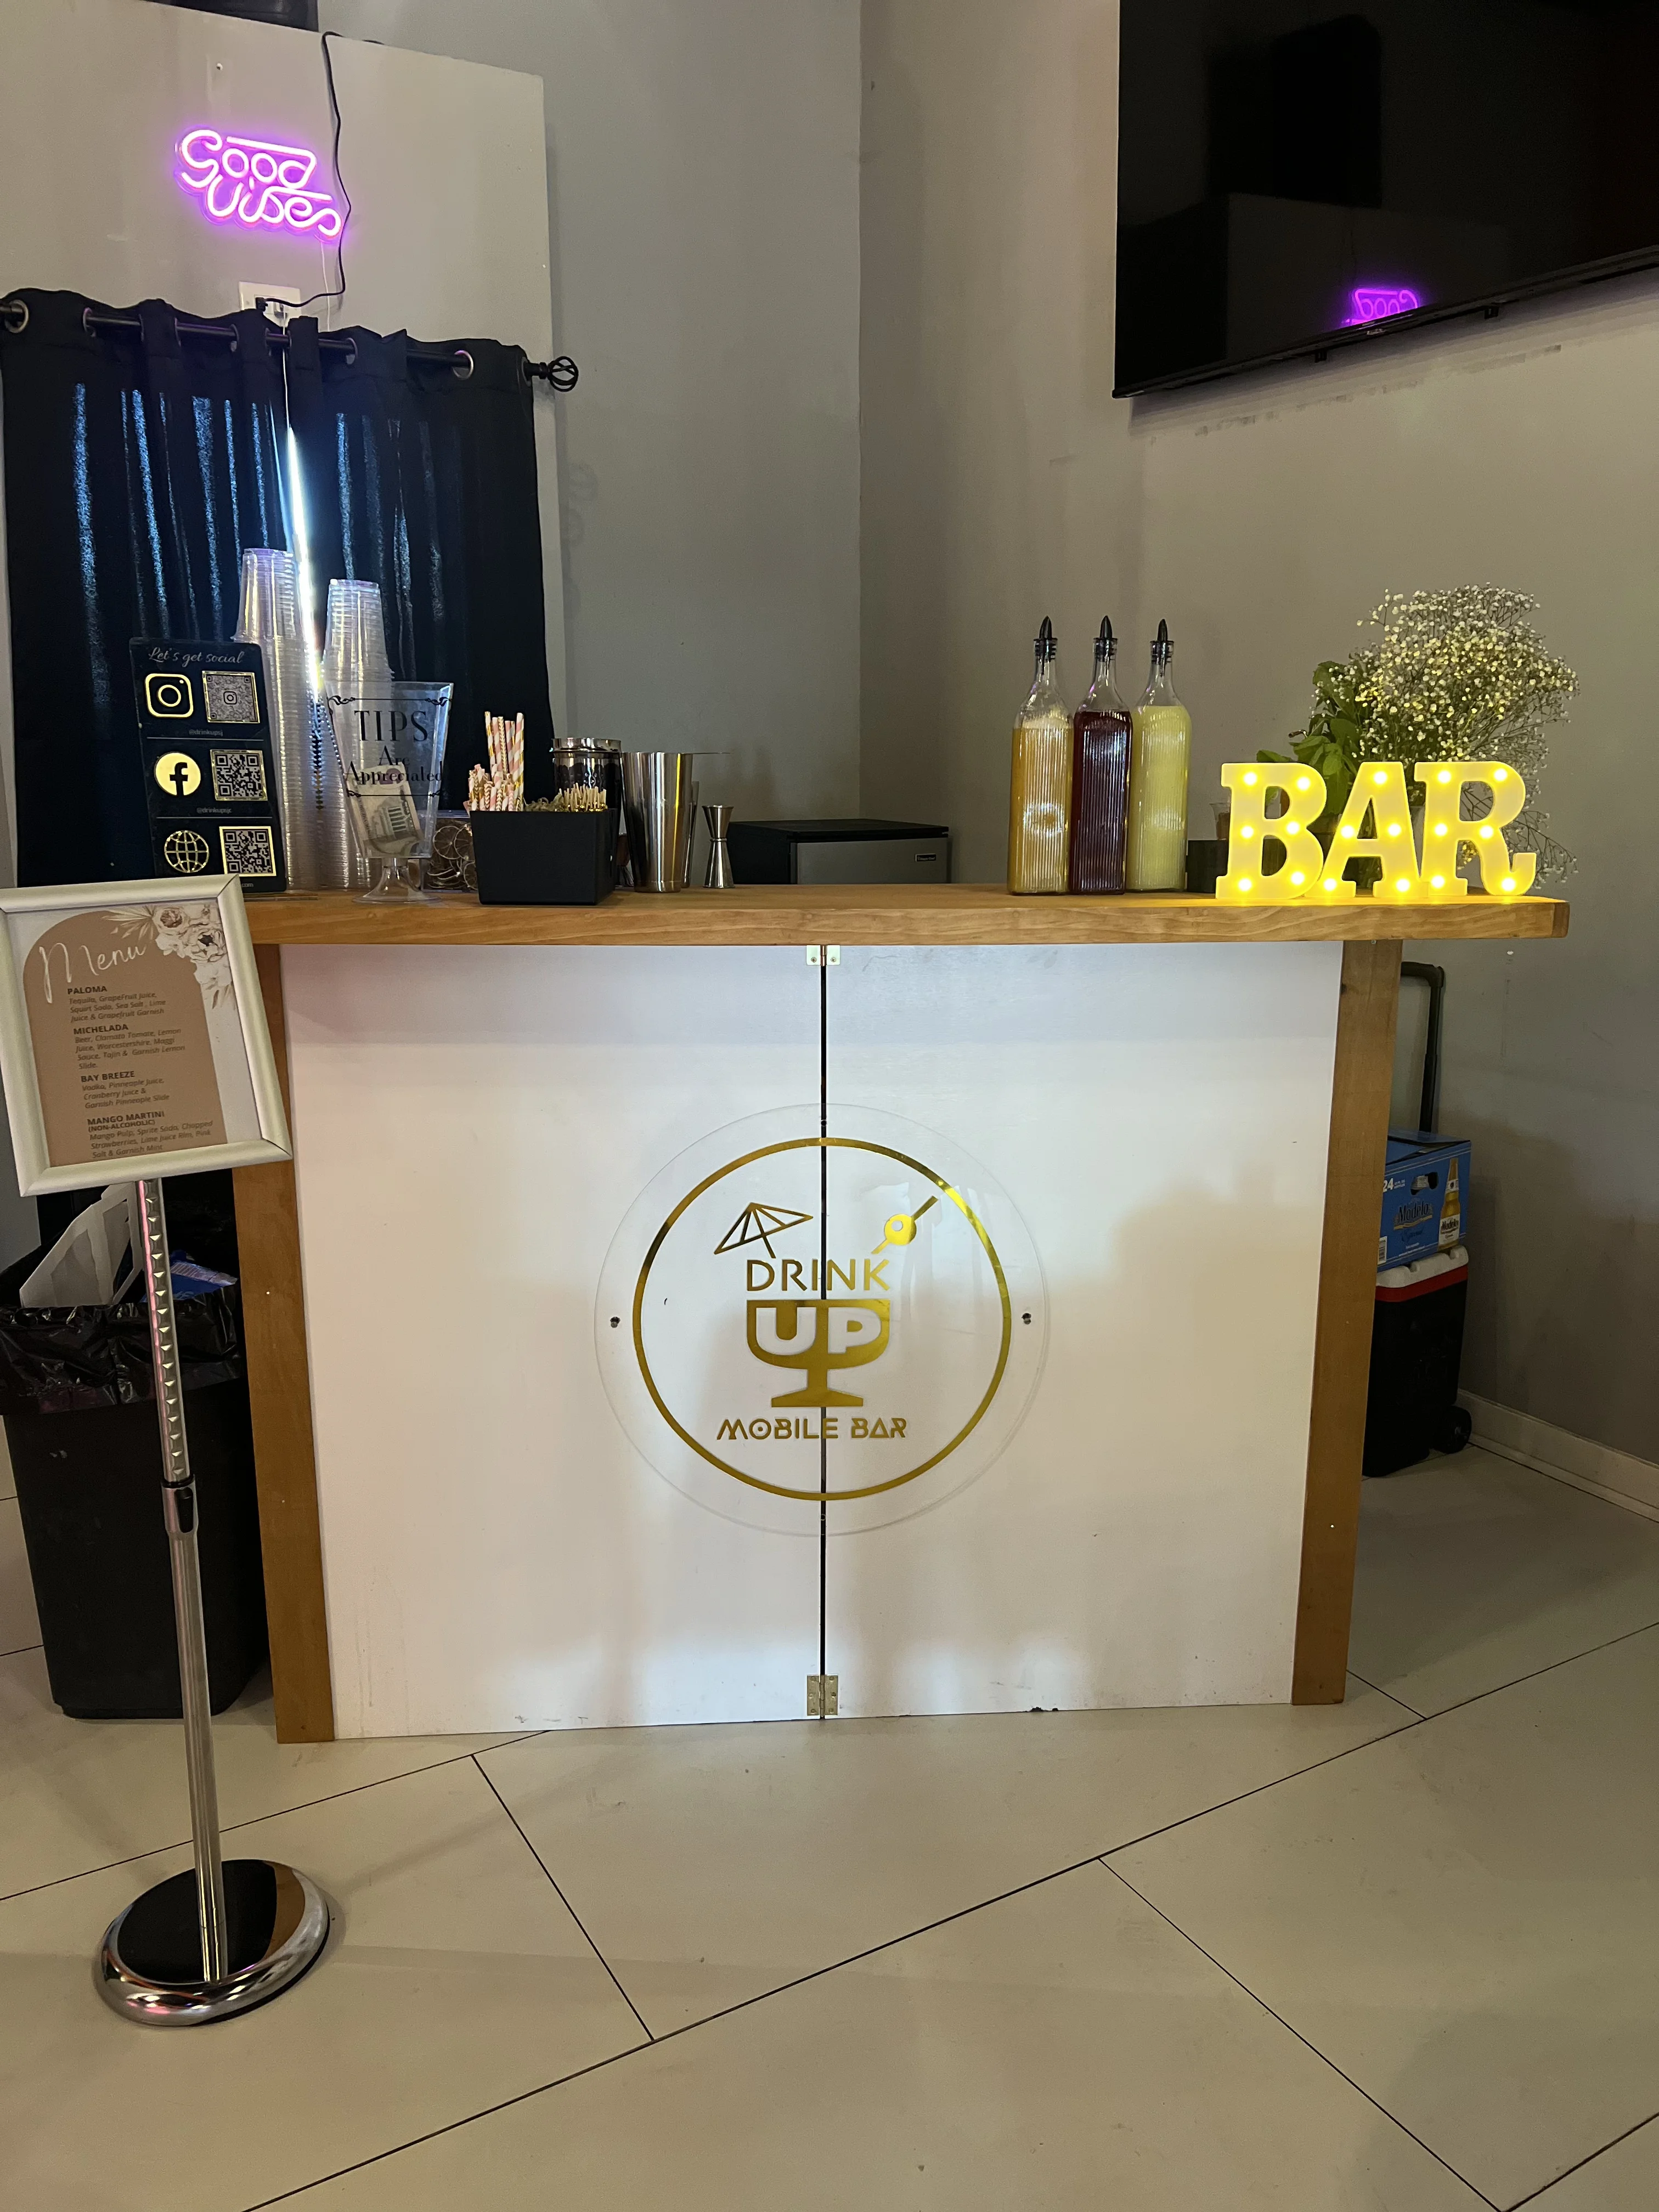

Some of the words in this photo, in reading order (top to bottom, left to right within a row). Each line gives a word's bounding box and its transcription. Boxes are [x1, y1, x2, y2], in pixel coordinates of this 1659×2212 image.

[148, 647, 179, 662] Let's
[182, 652, 203, 667] get
[206, 651, 245, 663] social
[354, 710, 427, 741] TIPS
[379, 745, 410, 766] Are
[1216, 761, 1536, 899] BAR
[40, 943, 146, 1003] Menu
[67, 986, 107, 994] PALOMA
[74, 1024, 128, 1034] MICHELADA
[102, 1071, 135, 1080] BREEZE
[84, 1091, 120, 1100] Cranberry
[85, 1099, 113, 1108] Garnish
[87, 1115, 123, 1125] MANGO
[126, 1111, 165, 1120] MARTINI
[88, 1119, 155, 1132] (NON-ALCOHOLIC)
[182, 1120, 213, 1130] Chopped
[1383, 1178, 1393, 1192] 24
[1398, 1200, 1429, 1222] Modelo
[747, 1259, 890, 1291] DRINK
[755, 1307, 881, 1356] UP
[716, 1418, 839, 1440] MOBILE
[851, 1417, 907, 1438] BAR
